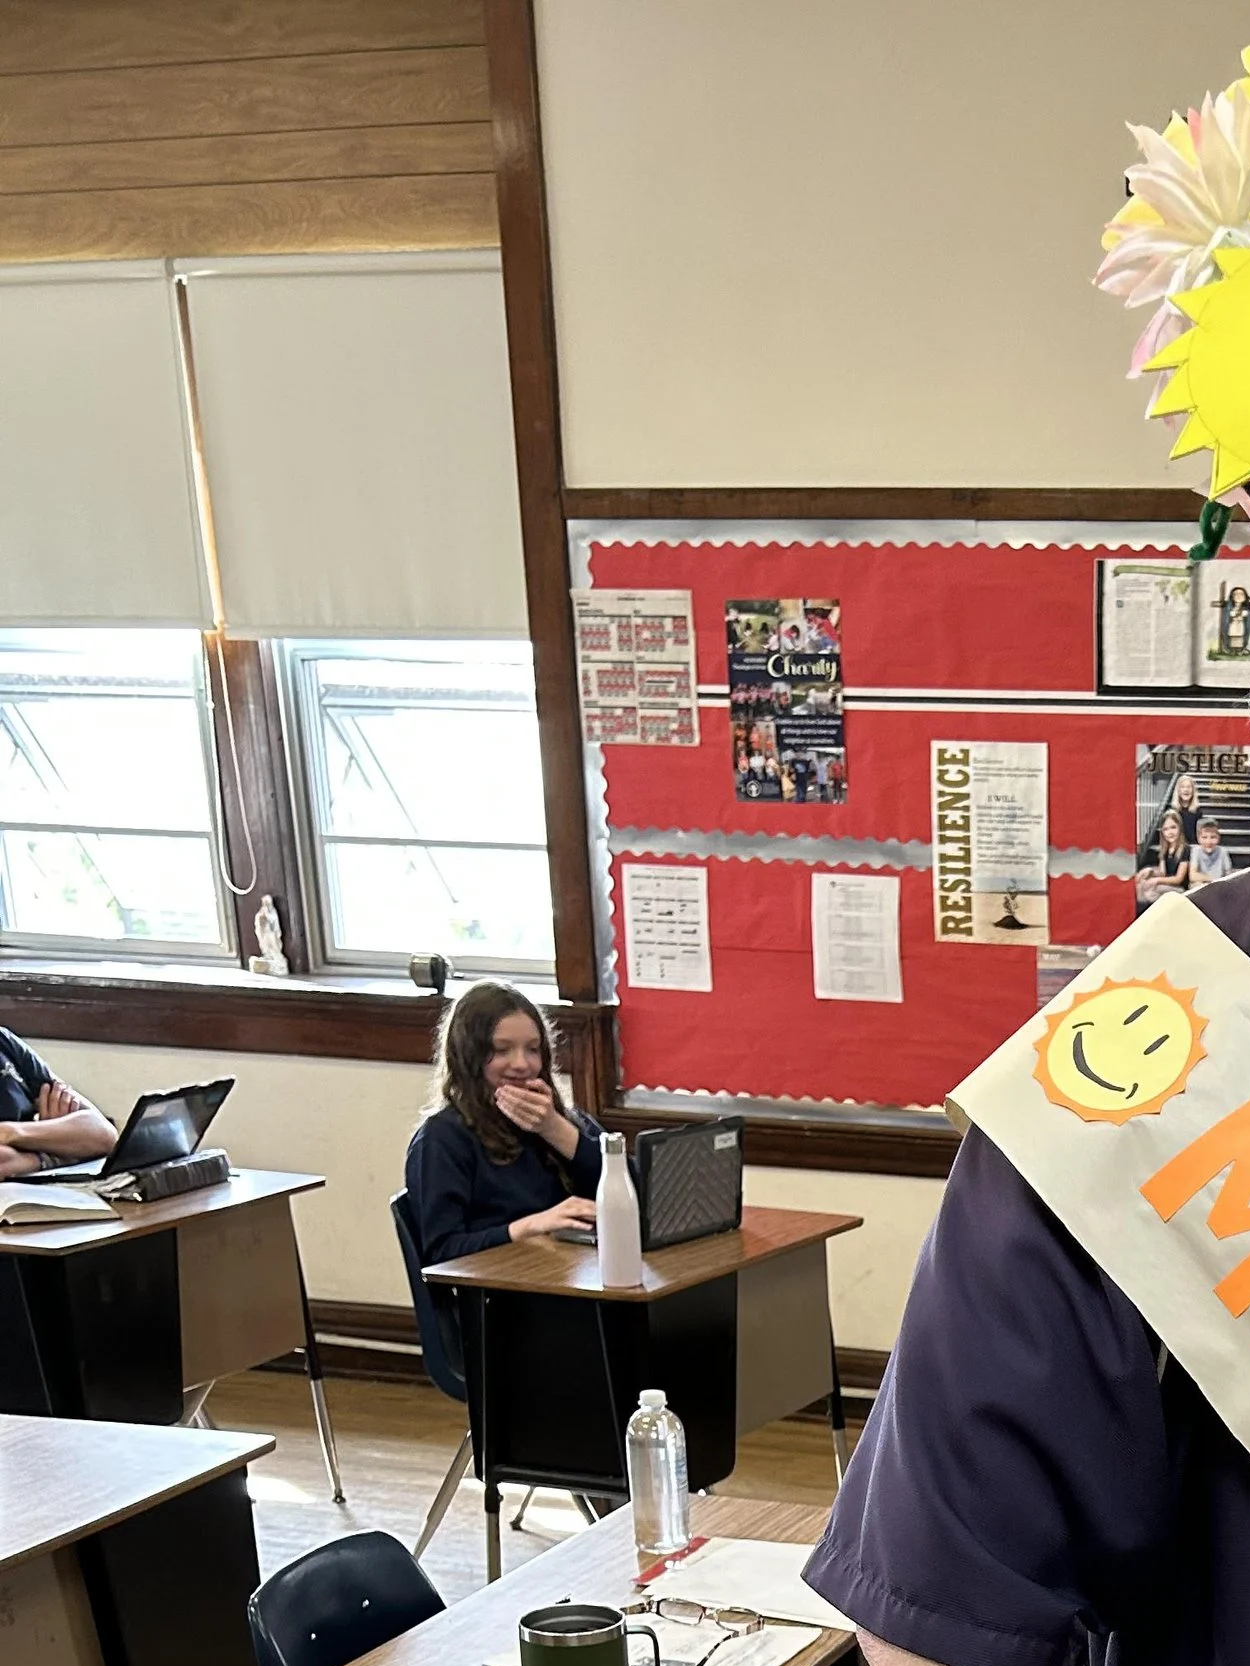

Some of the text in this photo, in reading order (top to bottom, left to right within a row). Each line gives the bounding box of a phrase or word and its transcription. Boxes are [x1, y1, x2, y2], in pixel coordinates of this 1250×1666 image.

[767, 653, 838, 682] Charity
[1147, 752, 1249, 773] JUSTICE
[936, 747, 974, 937] RESILIENCE
